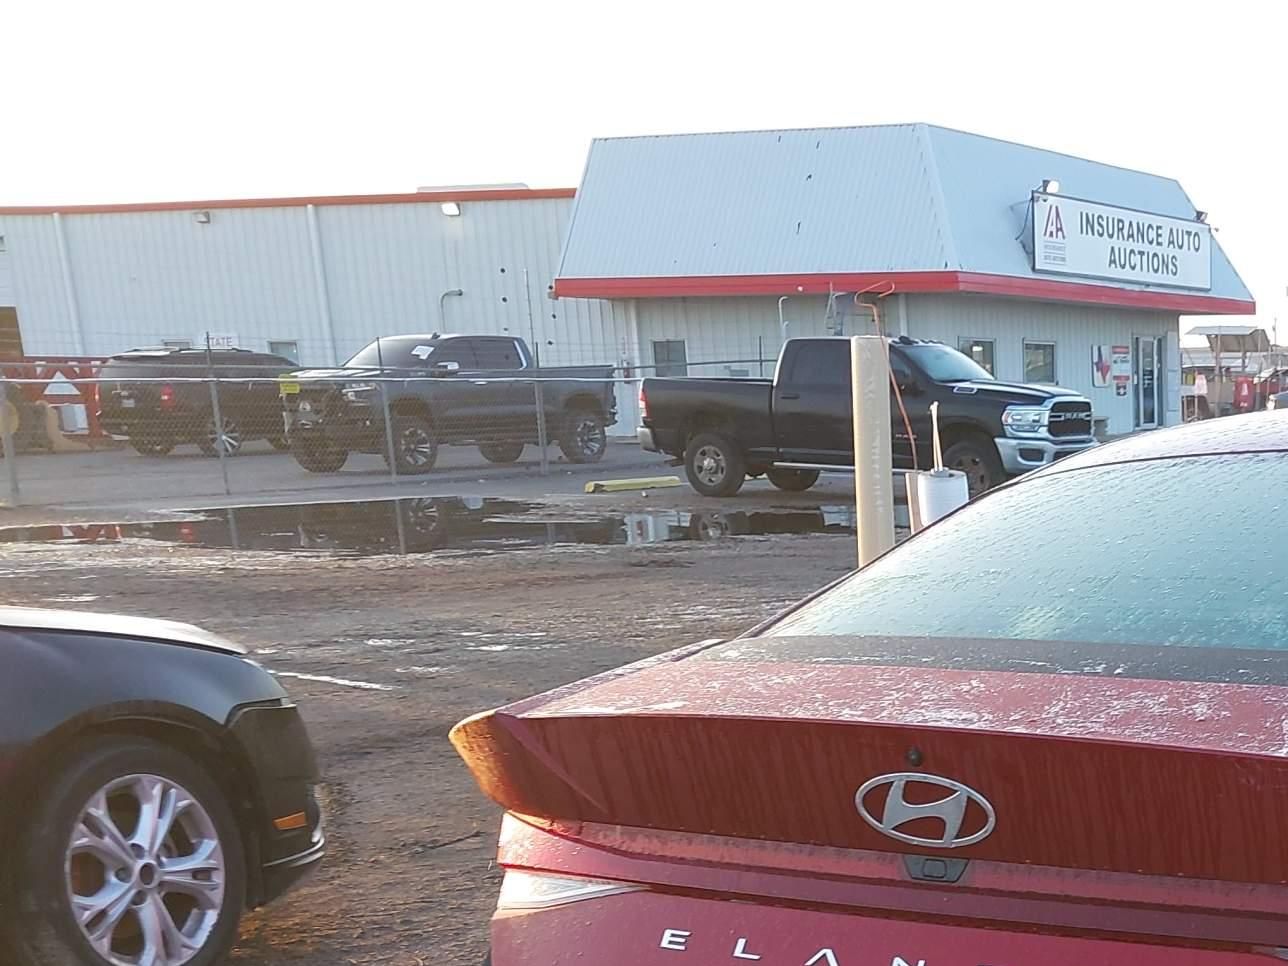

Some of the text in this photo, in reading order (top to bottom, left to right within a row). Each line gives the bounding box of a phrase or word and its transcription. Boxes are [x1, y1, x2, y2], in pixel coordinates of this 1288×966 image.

[1080, 211, 1201, 253] INSURANCE AUTO
[1108, 246, 1178, 277] AUCTIONS
